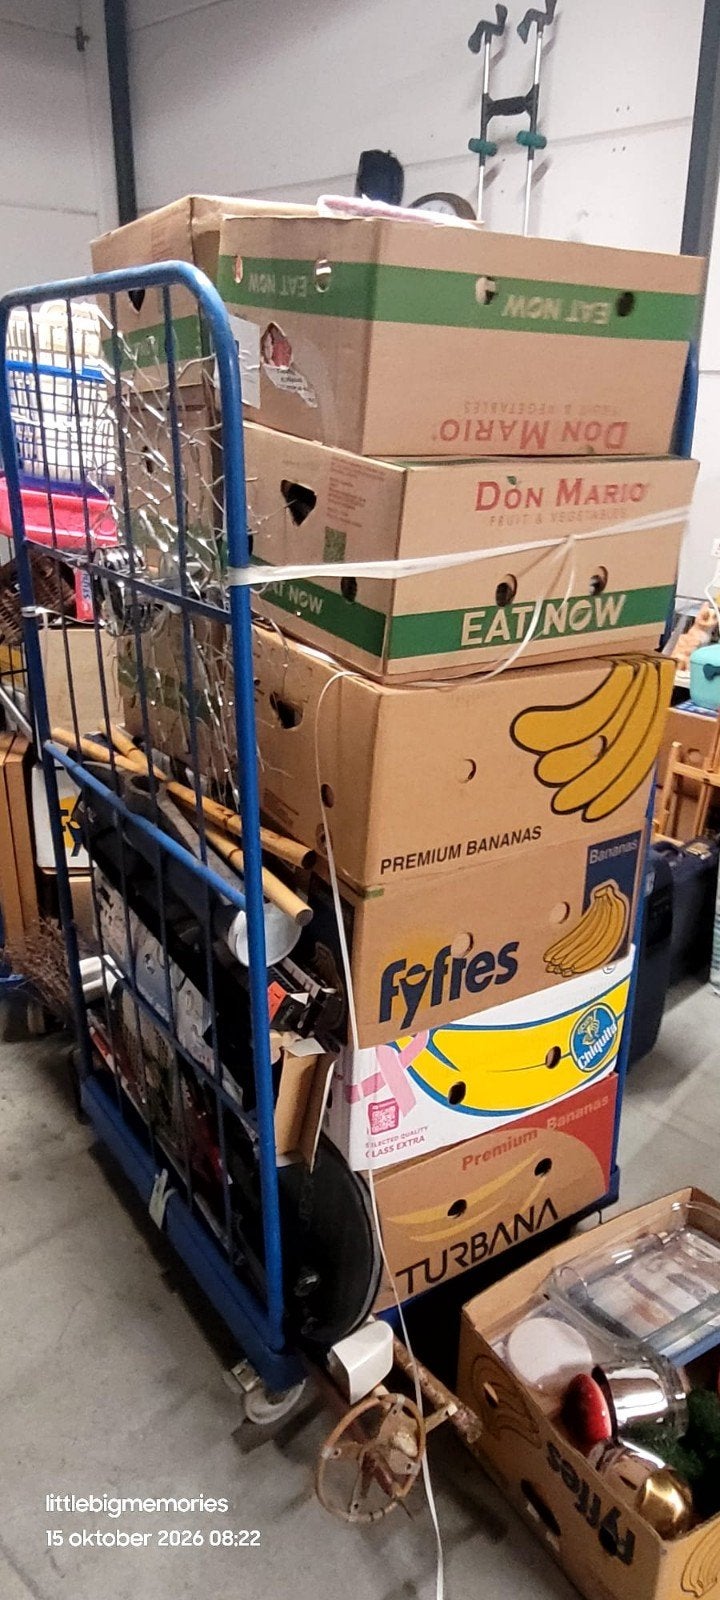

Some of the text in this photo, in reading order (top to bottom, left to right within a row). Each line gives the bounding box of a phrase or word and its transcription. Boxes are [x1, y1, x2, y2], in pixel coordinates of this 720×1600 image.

[283, 278, 308, 298] EAT
[504, 293, 610, 324] EAT NOW
[288, 584, 323, 614] NOW
[460, 594, 625, 646] EAT NOW
[380, 826, 543, 875] PREMIUM BANANAS
[589, 840, 638, 864] Bananas
[579, 1022, 618, 1071] Chiquita
[396, 1135, 425, 1150] EXTRA
[462, 1095, 610, 1171] Premium Bananas
[395, 1197, 559, 1295] TURBANA
